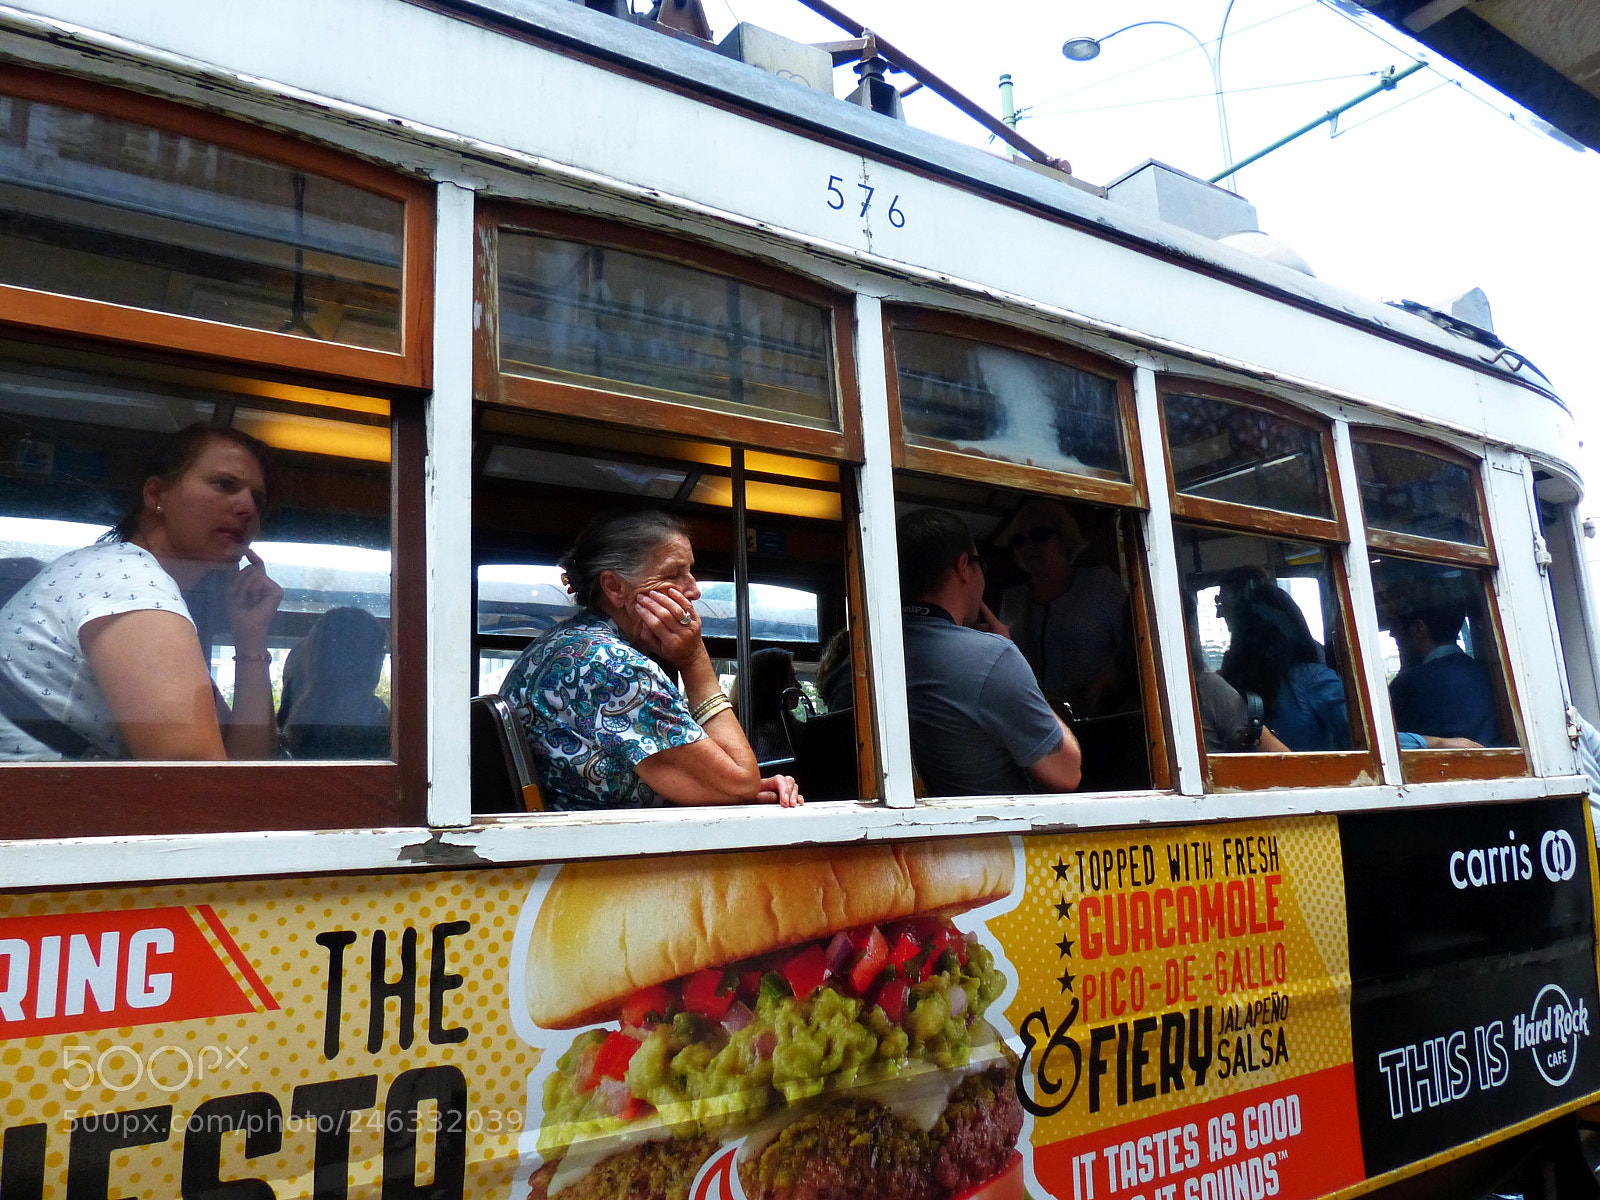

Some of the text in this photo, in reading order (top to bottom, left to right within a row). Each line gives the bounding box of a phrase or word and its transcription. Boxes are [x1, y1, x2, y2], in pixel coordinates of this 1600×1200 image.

[827, 175, 905, 228] 576
[1075, 835, 1280, 893] TOPPED WITH FRESH
[1450, 830, 1533, 890] carris
[1078, 874, 1285, 961] GUACAMOLE
[315, 920, 471, 1061] THE
[1082, 942, 1286, 1023] PICO-DE-GALLO
[1217, 991, 1289, 1036] JALAPEÑO
[1512, 998, 1591, 1051] Hard Rock
[1089, 1005, 1213, 1114] FIERY
[1217, 1027, 1289, 1080] SALSA
[1379, 1020, 1510, 1120] THIS IS
[1547, 1049, 1567, 1068] CAFE
[1072, 1094, 1302, 1200] IT TASTES AS GOOD
